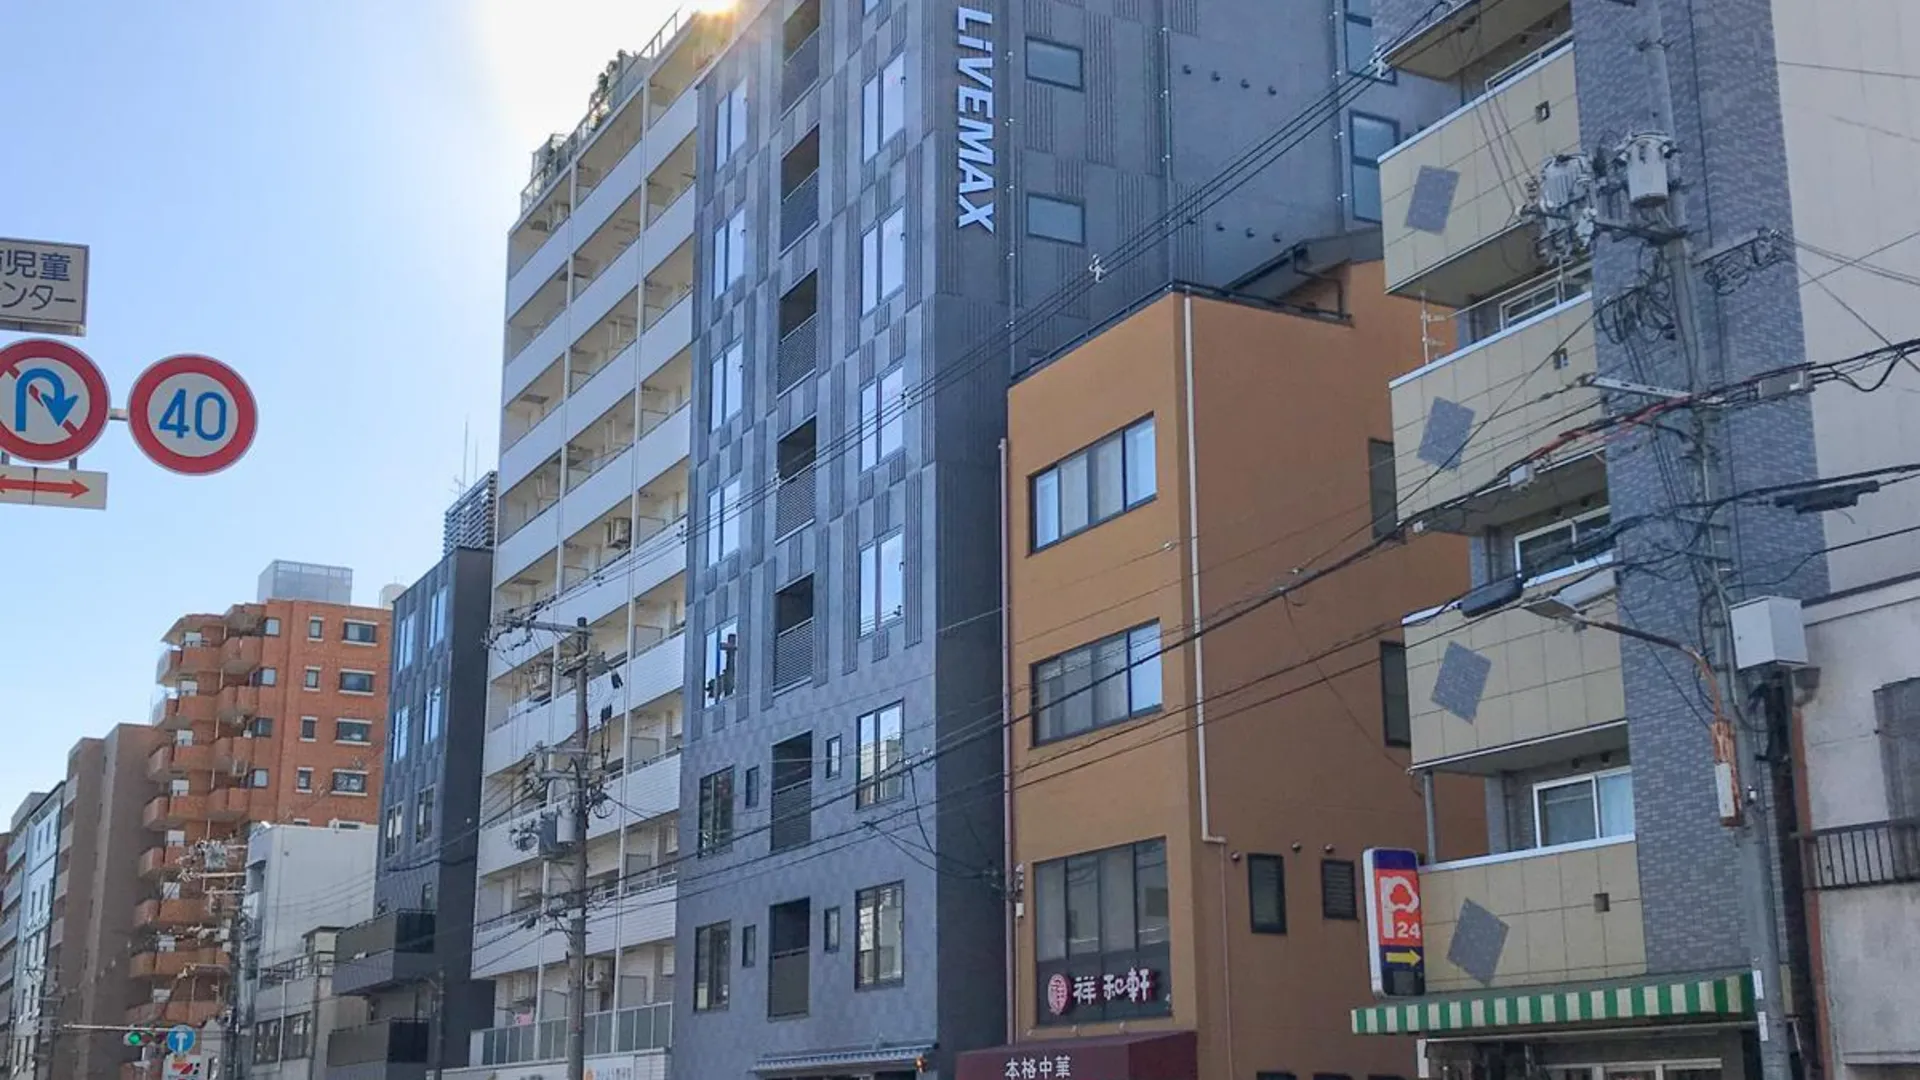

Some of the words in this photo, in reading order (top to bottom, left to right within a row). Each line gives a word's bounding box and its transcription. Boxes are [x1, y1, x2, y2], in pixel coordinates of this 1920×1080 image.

[0, 248, 71, 281] 児童
[0, 281, 76, 311] ンター
[159, 388, 227, 441] 40
[1396, 921, 1421, 939] 24
[1004, 1054, 1071, 1080] 本格中華
